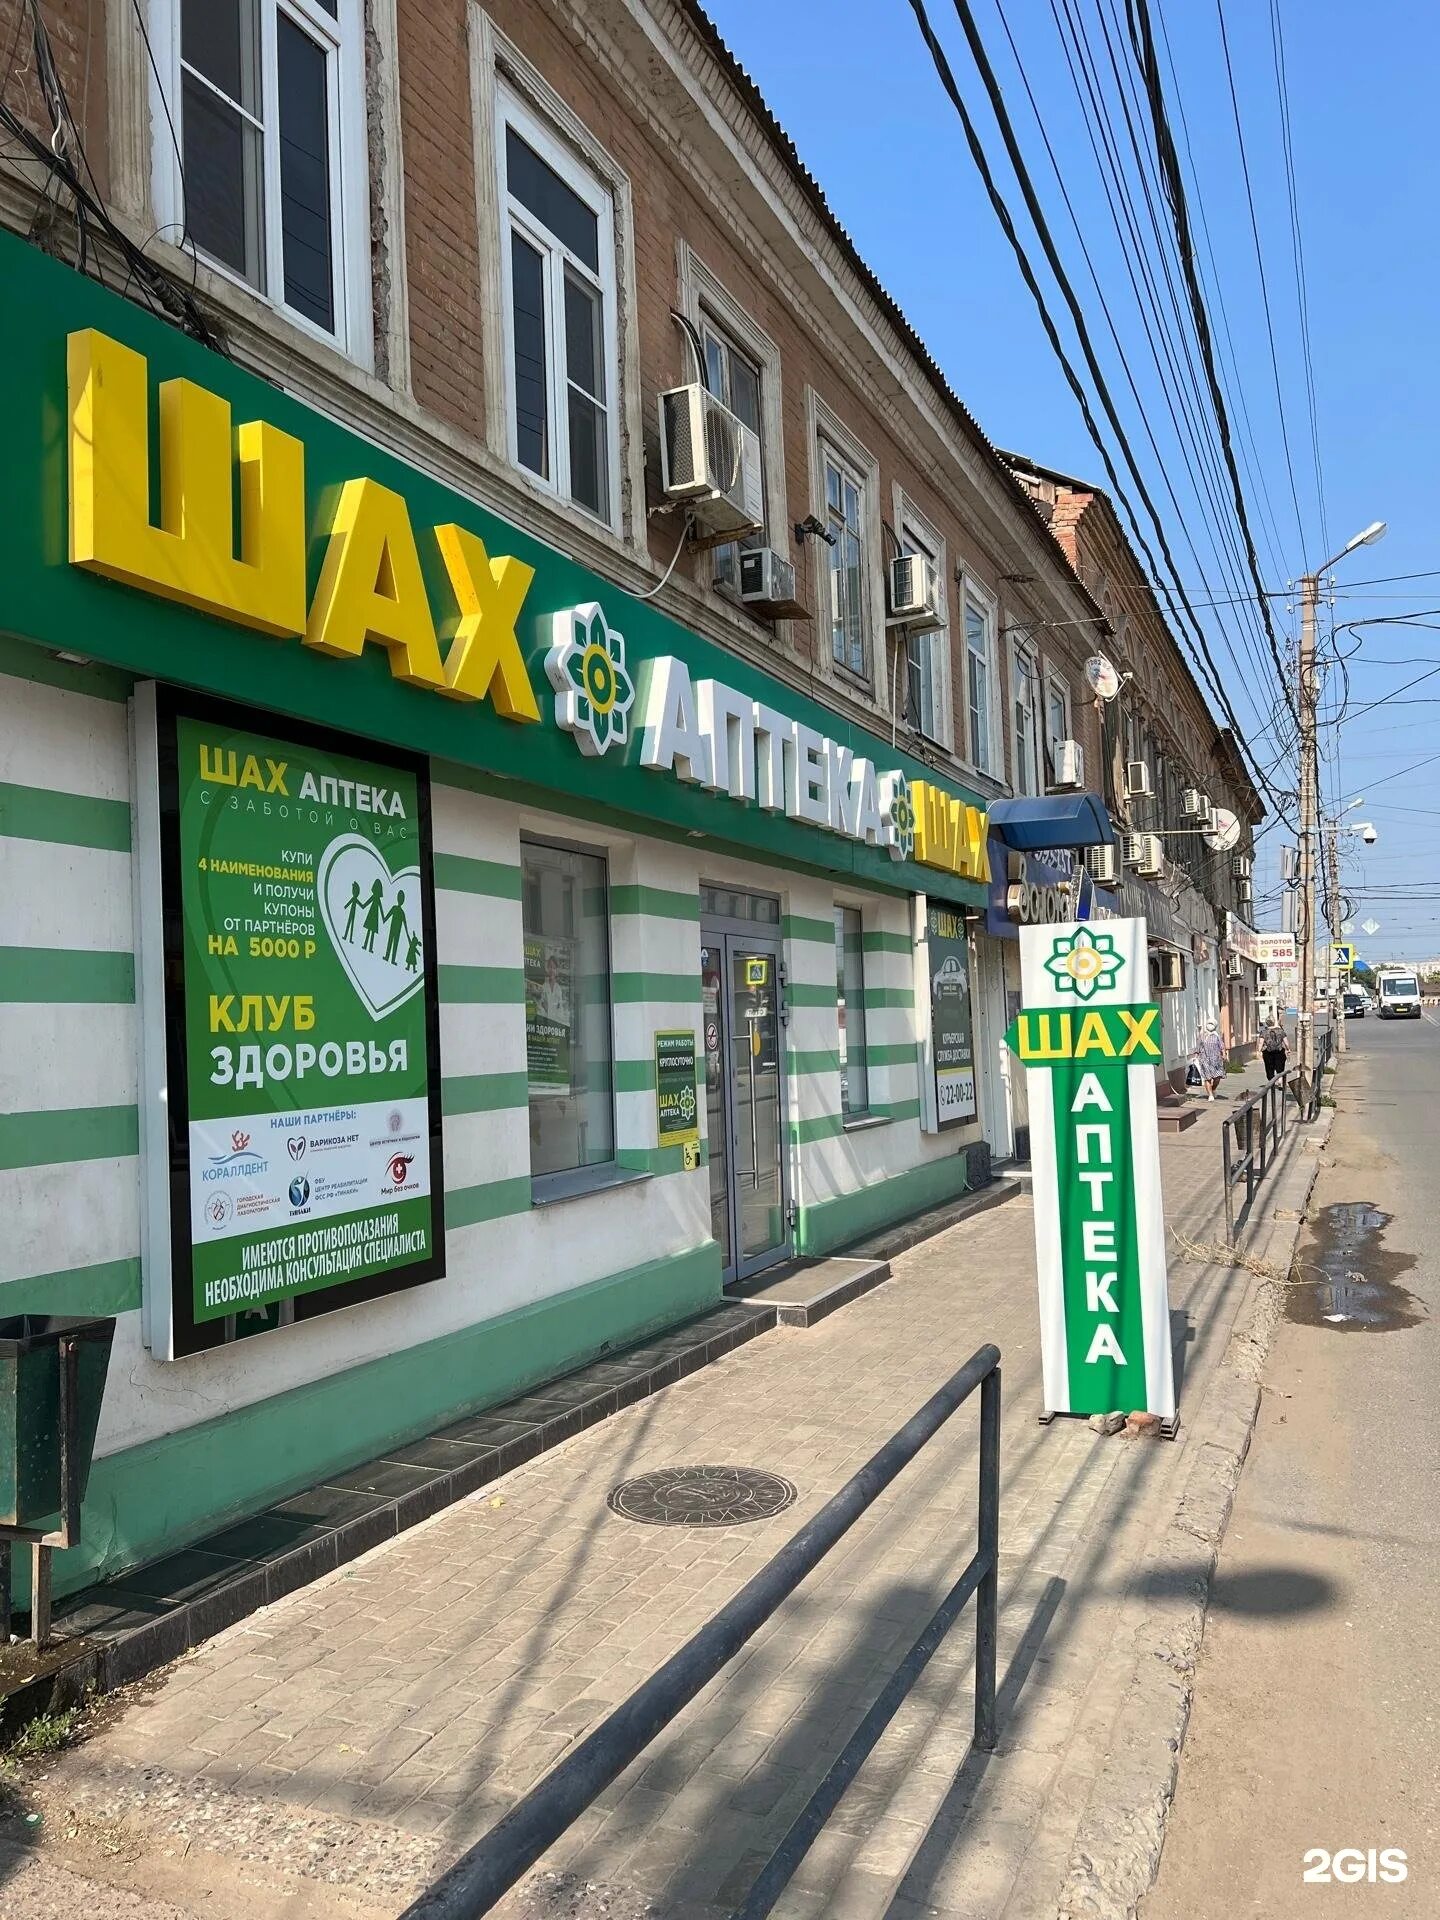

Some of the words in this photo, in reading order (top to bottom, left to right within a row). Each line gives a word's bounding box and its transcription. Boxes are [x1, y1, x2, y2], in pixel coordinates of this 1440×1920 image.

[67, 328, 542, 724] ШАХ
[640, 655, 888, 847] АПТЕКА
[200, 744, 289, 797] ШАХ
[299, 772, 406, 819] АПТЕКА
[200, 791, 210, 805] С
[231, 796, 333, 827] ЗАБОТОЙ
[350, 818, 358, 830] О
[374, 822, 407, 839] ВАС
[911, 780, 992, 883] ШАХ
[281, 850, 313, 866] КУПИ
[198, 858, 207, 871] 4
[211, 859, 314, 883] НАИМЕНОВАНИЯ
[254, 883, 262, 895] И
[266, 884, 314, 901] ПОЛУЧИ
[264, 902, 315, 918] КУПОНЫ
[224, 918, 240, 931] ОТ
[245, 919, 315, 936] ПАРТНЁРОВ
[938, 912, 958, 939] ШАХ
[208, 935, 239, 955] НА
[249, 937, 300, 958] 5000
[1272, 949, 1293, 957] 585
[209, 995, 315, 1033] КЛУБ
[657, 1040, 674, 1048] РЕЖИМ
[676, 1039, 693, 1047] РАБОТЫ
[1018, 1010, 1161, 1059] ШАХ
[210, 1040, 408, 1090] ЗДОРОВЬЯ
[660, 1093, 679, 1107] ШАХ
[946, 1082, 973, 1105] 22-00-22
[270, 1113, 300, 1129] НАШИ
[304, 1110, 357, 1125] ПАРТНЁРЫ:
[660, 1107, 680, 1118] АПТЕКА
[310, 1136, 345, 1148] ВАРИКОЗА
[347, 1134, 359, 1143] НЕТ
[202, 1161, 268, 1181] КОРАЛЛДЕНТ
[381, 1186, 393, 1196] Мир
[394, 1183, 403, 1193] без
[1071, 1072, 1128, 1365] АПТЕКА
[242, 1237, 295, 1271] ИМЕЮТСЯ
[298, 1213, 399, 1255] ПРОТИВОПОКАЗАНИЯ
[205, 1269, 284, 1307] НЕОБХОДИМА
[286, 1246, 362, 1286] КОНСУЛЬТАЦИЯ
[364, 1229, 426, 1265] СПЕЦИАЛИСТА
